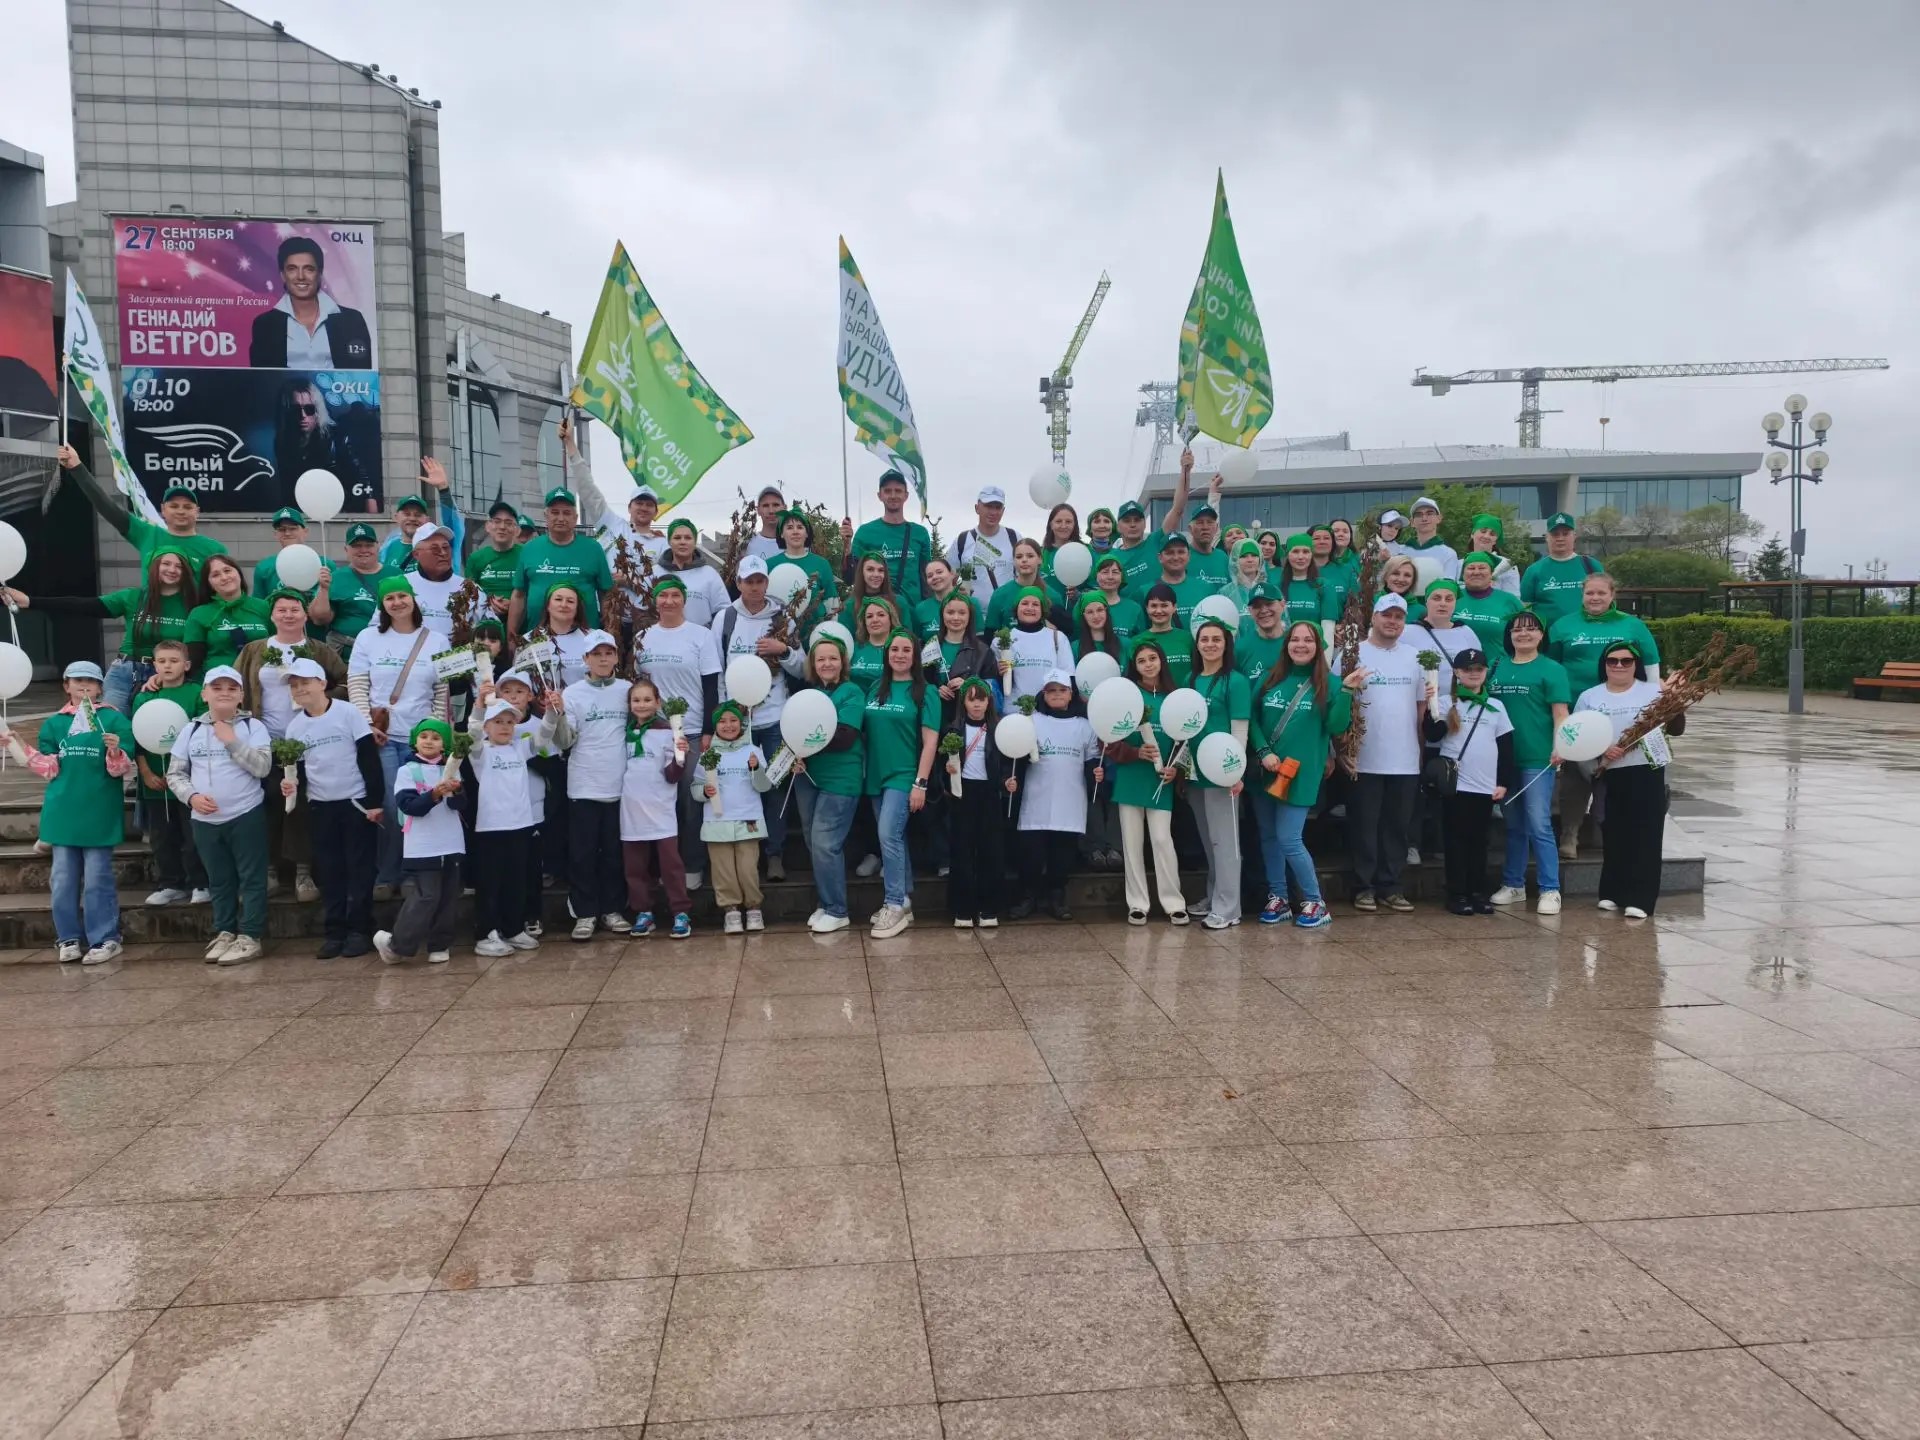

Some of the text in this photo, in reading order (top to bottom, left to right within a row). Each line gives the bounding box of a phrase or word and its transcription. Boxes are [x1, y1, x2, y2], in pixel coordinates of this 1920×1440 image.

[125, 226, 234, 250] 27 СЕНТЯБРЯ
[331, 231, 364, 244] ОКЦ
[161, 240, 195, 251] 18:00
[128, 294, 269, 307] Заслуженный артист России
[845, 287, 880, 326] НАУ
[128, 307, 216, 328] ГЕННАДИЙ
[129, 330, 237, 357] ВЕТРОВ
[348, 344, 366, 354] 12+
[132, 378, 191, 397] 01.10
[331, 381, 369, 396] ОКЦ
[133, 399, 174, 412] 19:00
[144, 453, 223, 471] Белый
[352, 484, 373, 496] 6+
